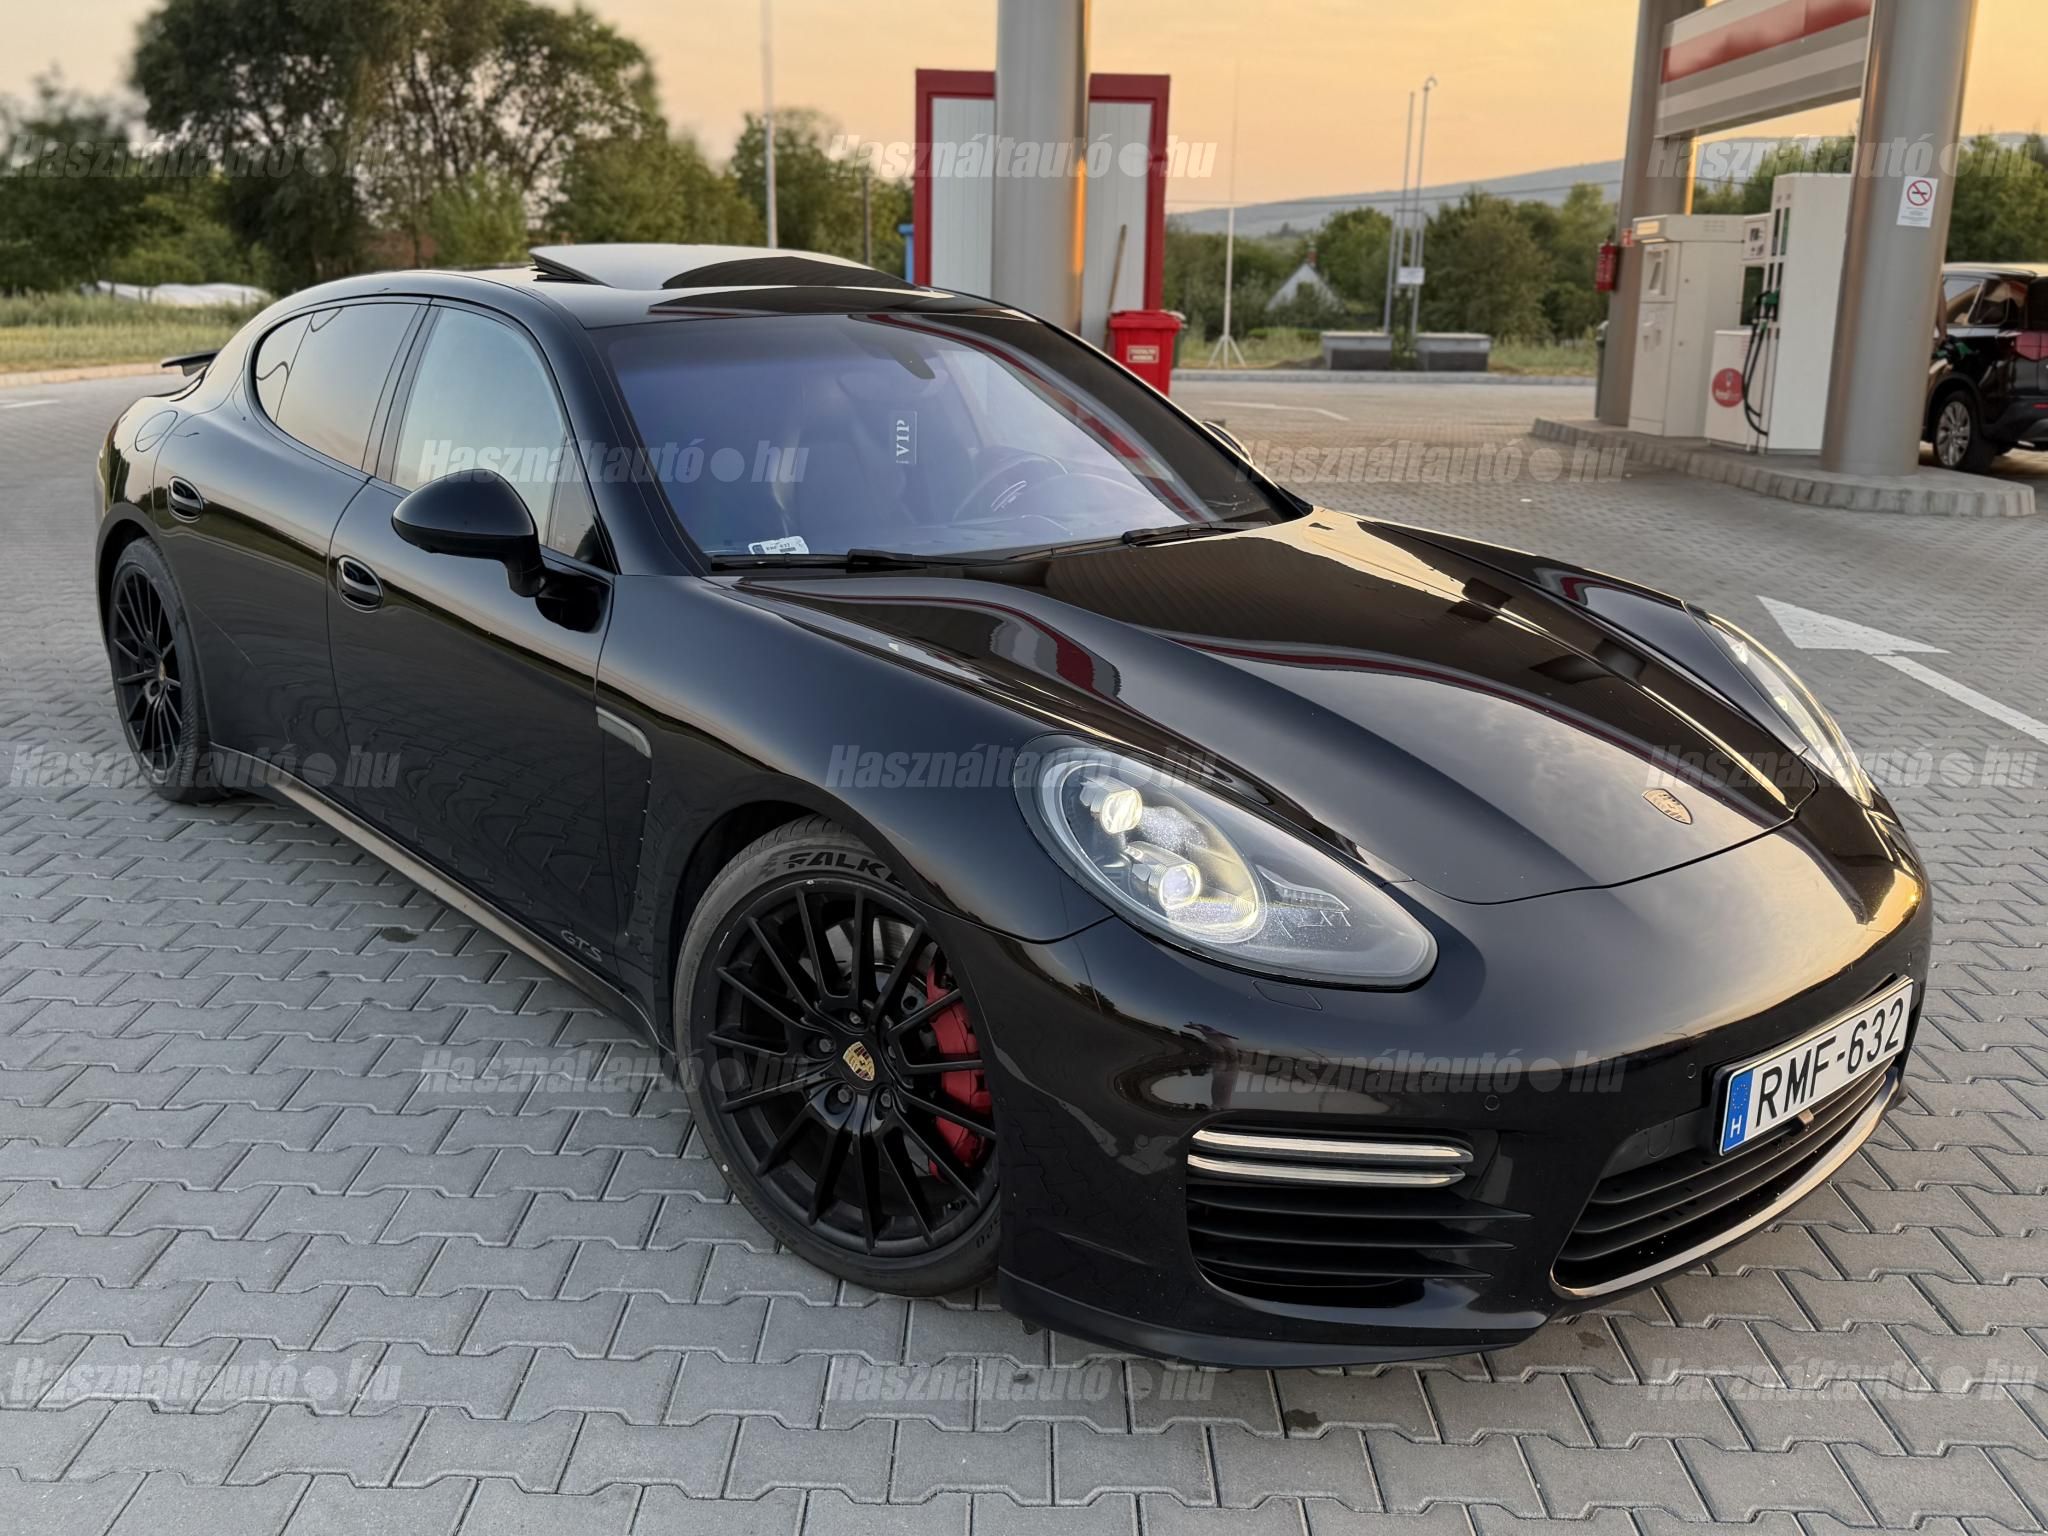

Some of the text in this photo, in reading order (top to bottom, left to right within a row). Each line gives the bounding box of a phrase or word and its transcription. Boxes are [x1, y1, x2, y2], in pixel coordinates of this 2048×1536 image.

[895, 419, 910, 457] VIP
[560, 929, 602, 962] GTS
[1755, 997, 1905, 1128] RMF-632
[1729, 1114, 1743, 1139] H
